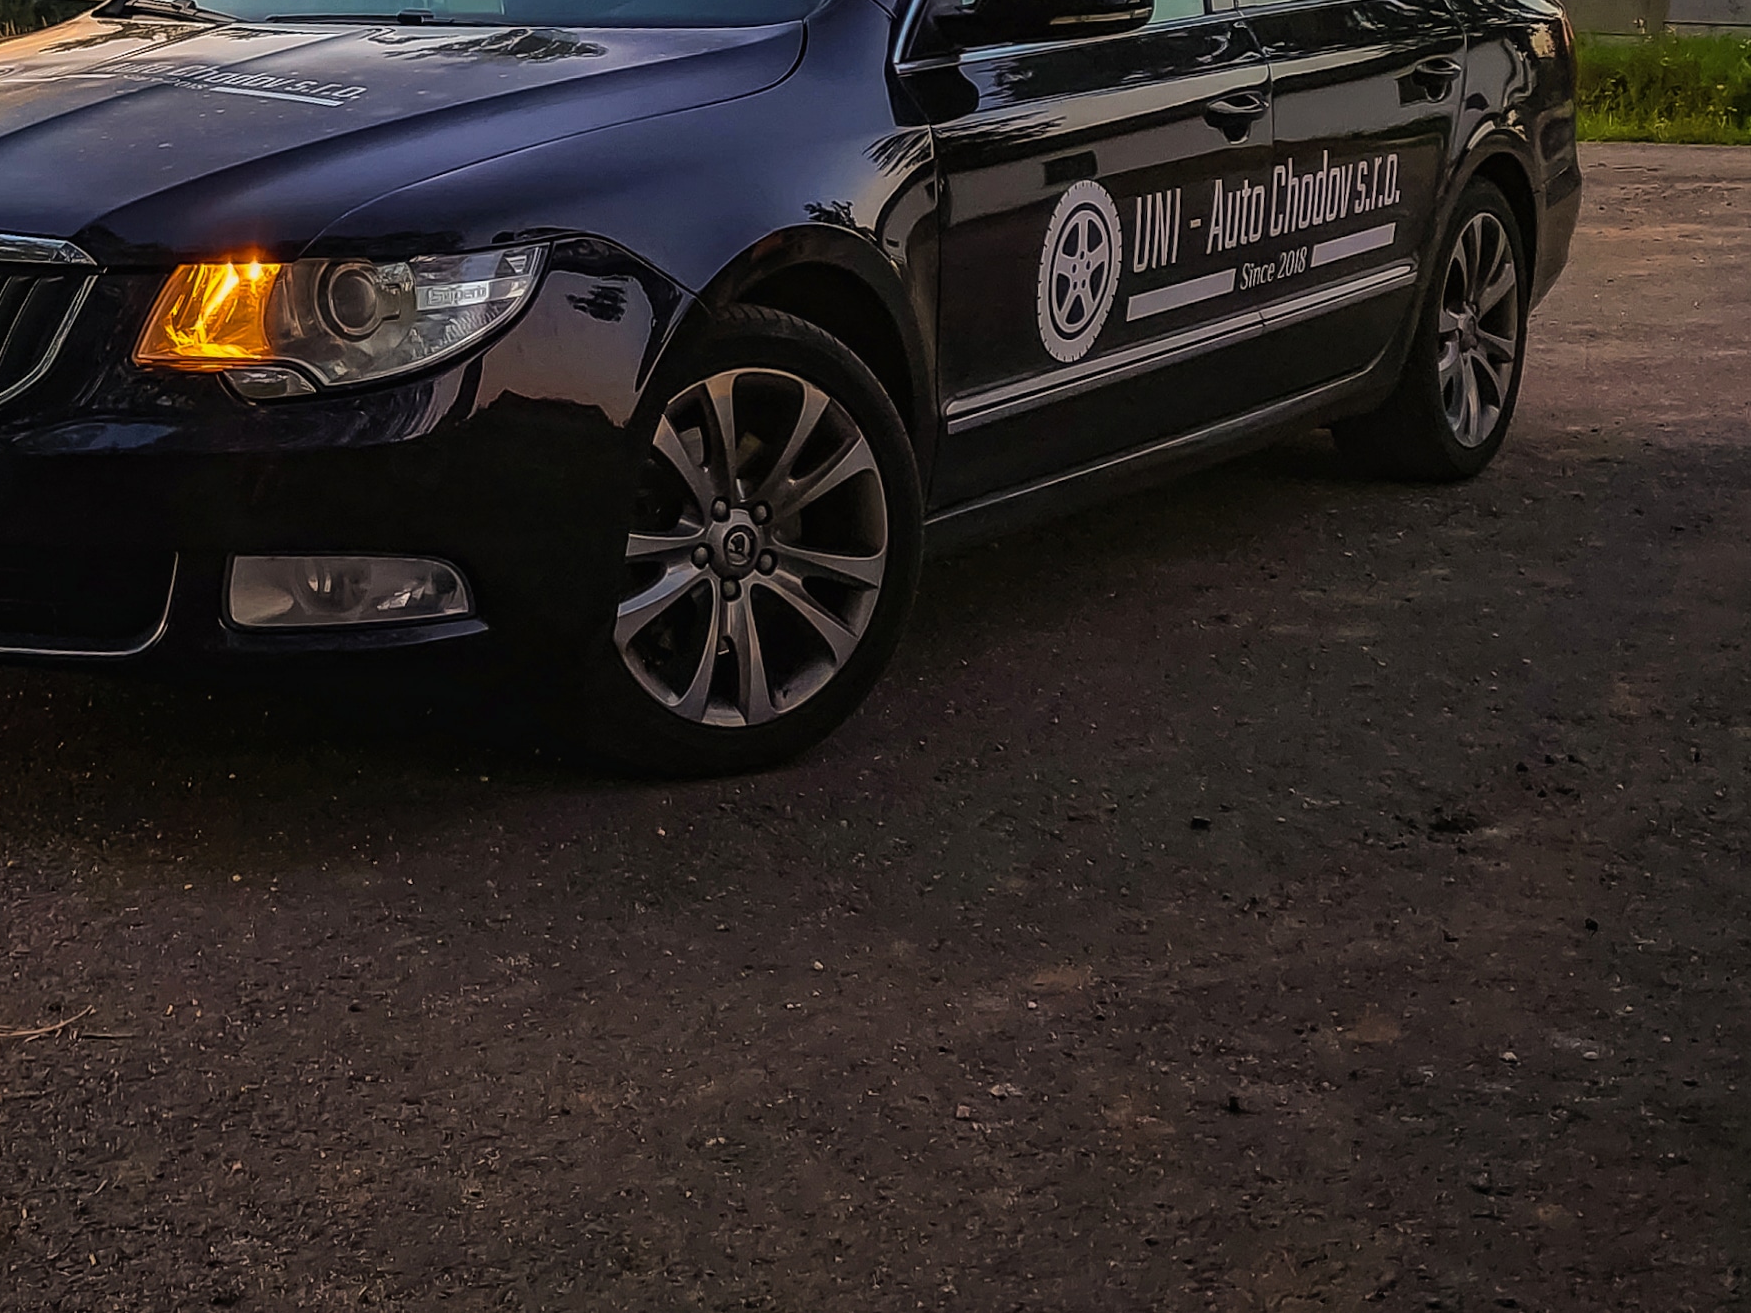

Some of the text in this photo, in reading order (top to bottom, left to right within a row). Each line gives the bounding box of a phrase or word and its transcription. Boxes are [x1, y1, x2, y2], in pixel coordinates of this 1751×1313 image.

[167, 64, 294, 89] Chodov
[1133, 149, 1402, 273] UNI - Auto Chodov s.r.o.
[1240, 245, 1308, 291] Since 2018
